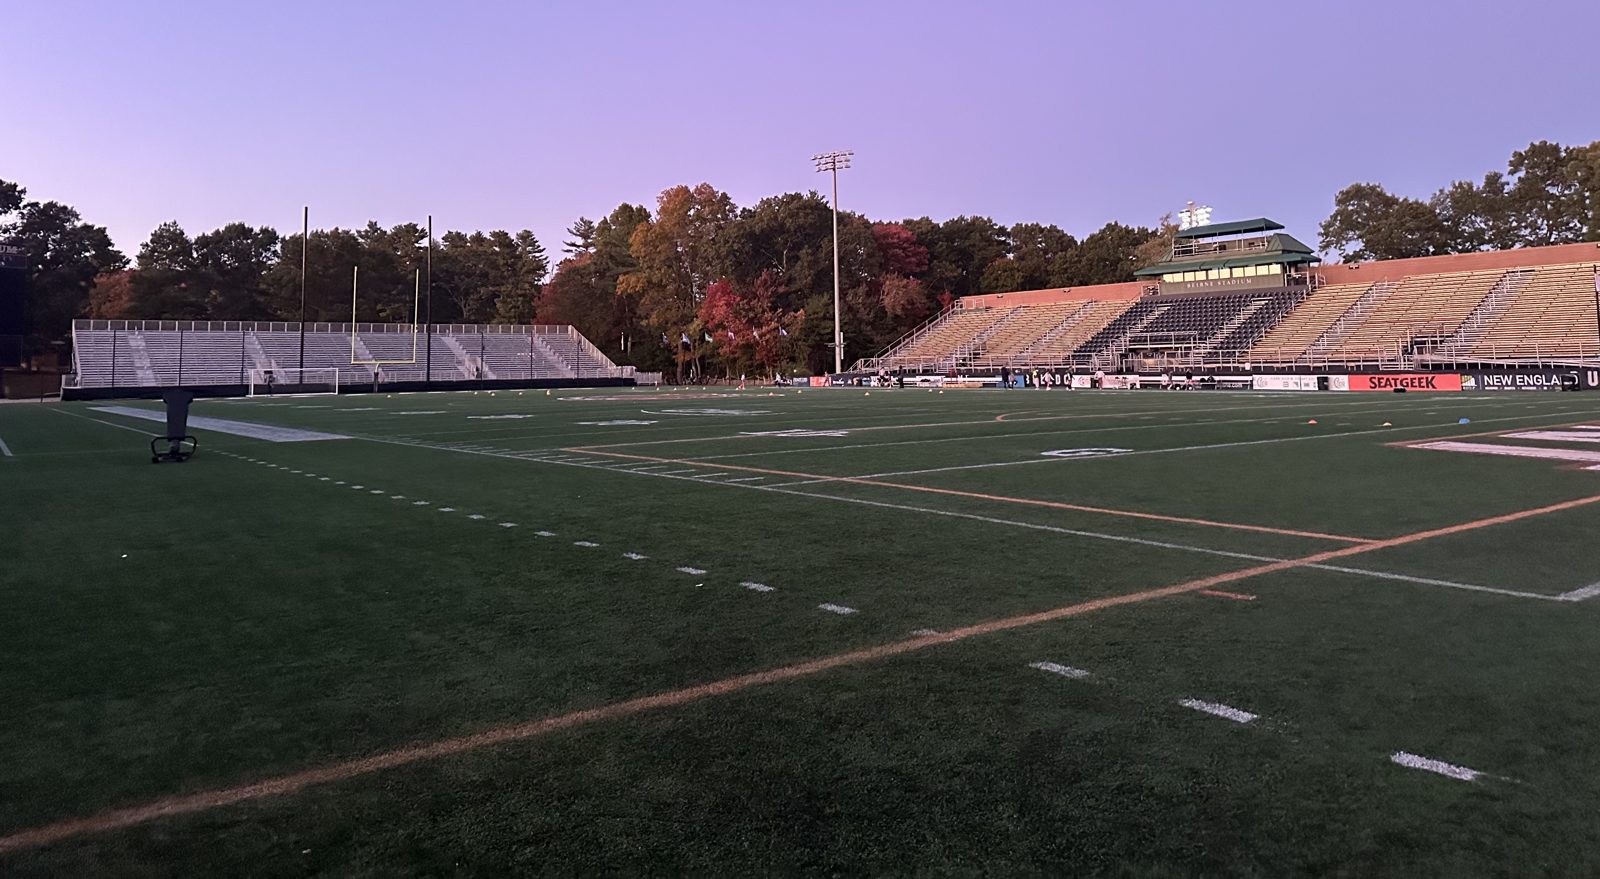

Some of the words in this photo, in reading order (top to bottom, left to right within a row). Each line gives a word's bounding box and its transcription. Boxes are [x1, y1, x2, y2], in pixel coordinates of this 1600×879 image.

[1186, 281, 1213, 289] BEIRNE
[1217, 278, 1252, 286] STADIUM
[1369, 376, 1437, 389] SEATGEEK
[1484, 374, 1512, 386] NEW
[1515, 374, 1579, 386] ENGLA
